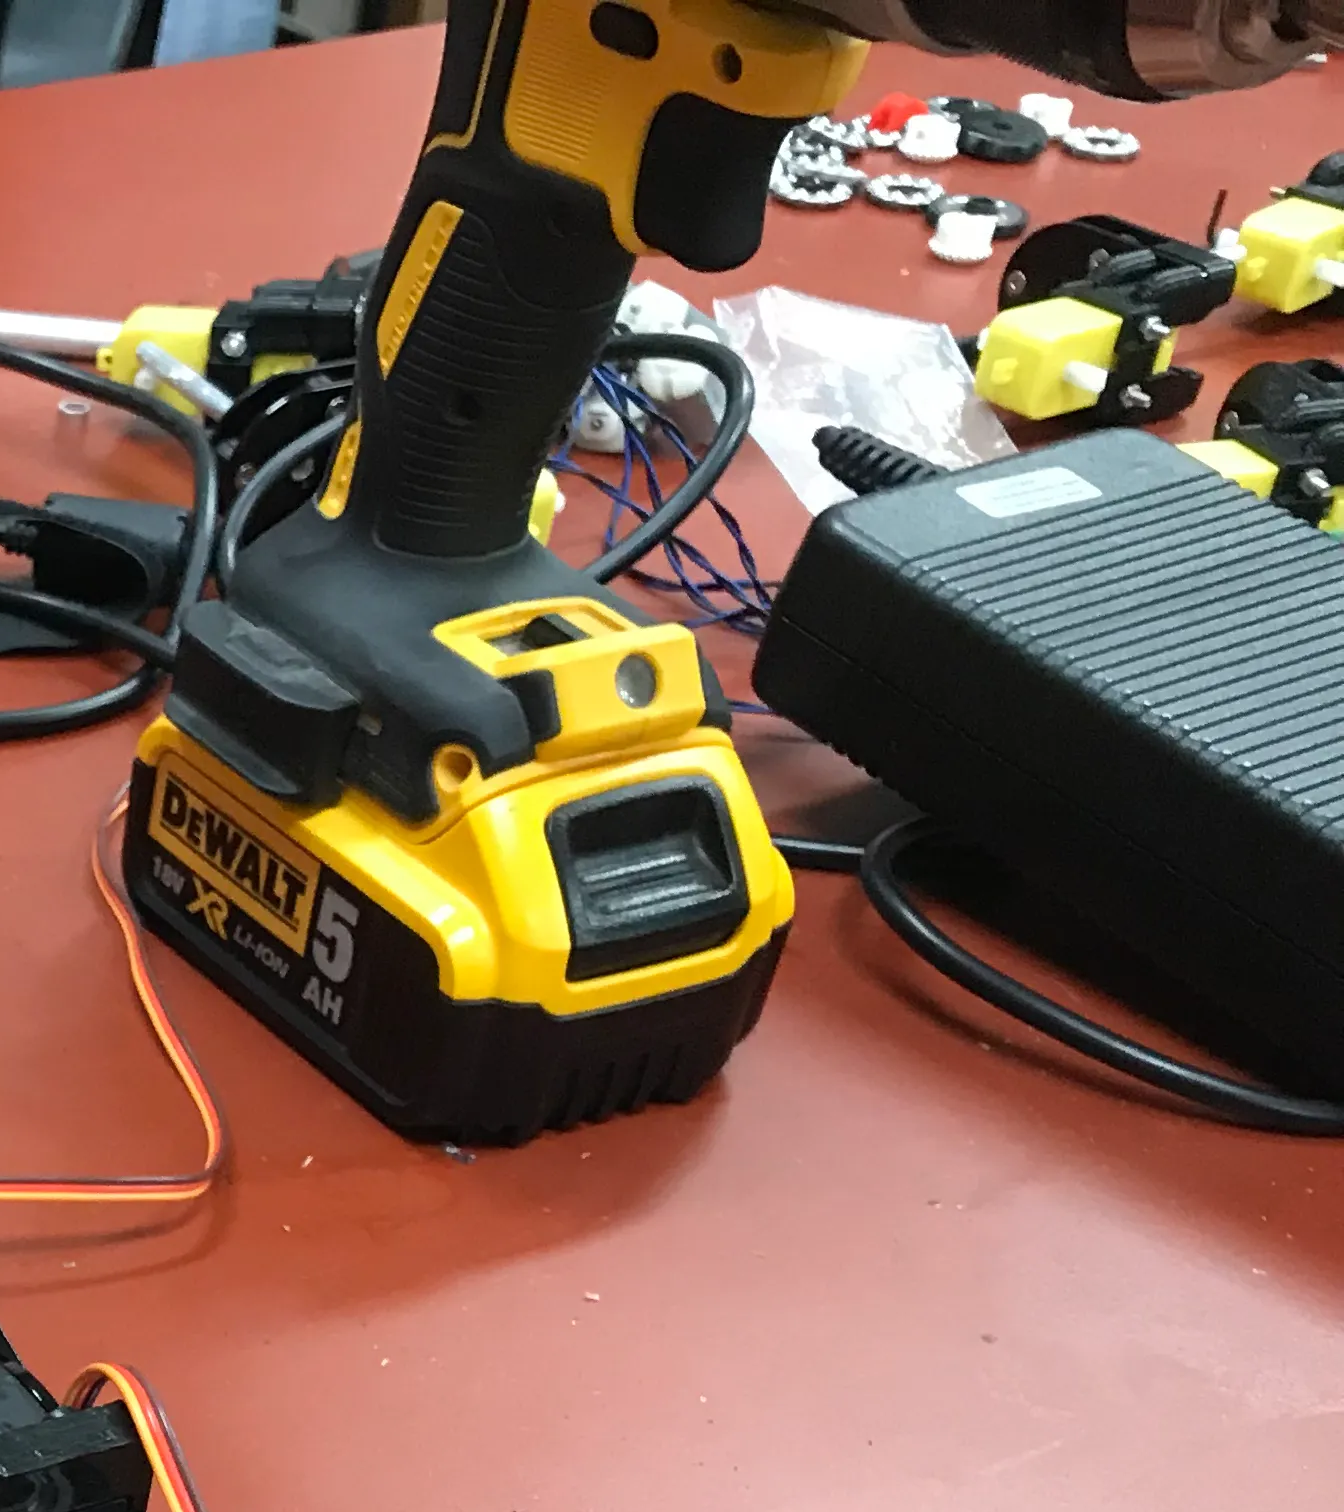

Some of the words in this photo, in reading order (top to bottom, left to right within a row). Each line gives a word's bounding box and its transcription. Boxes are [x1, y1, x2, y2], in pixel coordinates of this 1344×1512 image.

[153, 856, 186, 895] 18V
[185, 876, 229, 940] XR
[312, 886, 360, 983] 5
[301, 976, 344, 1025] AH
